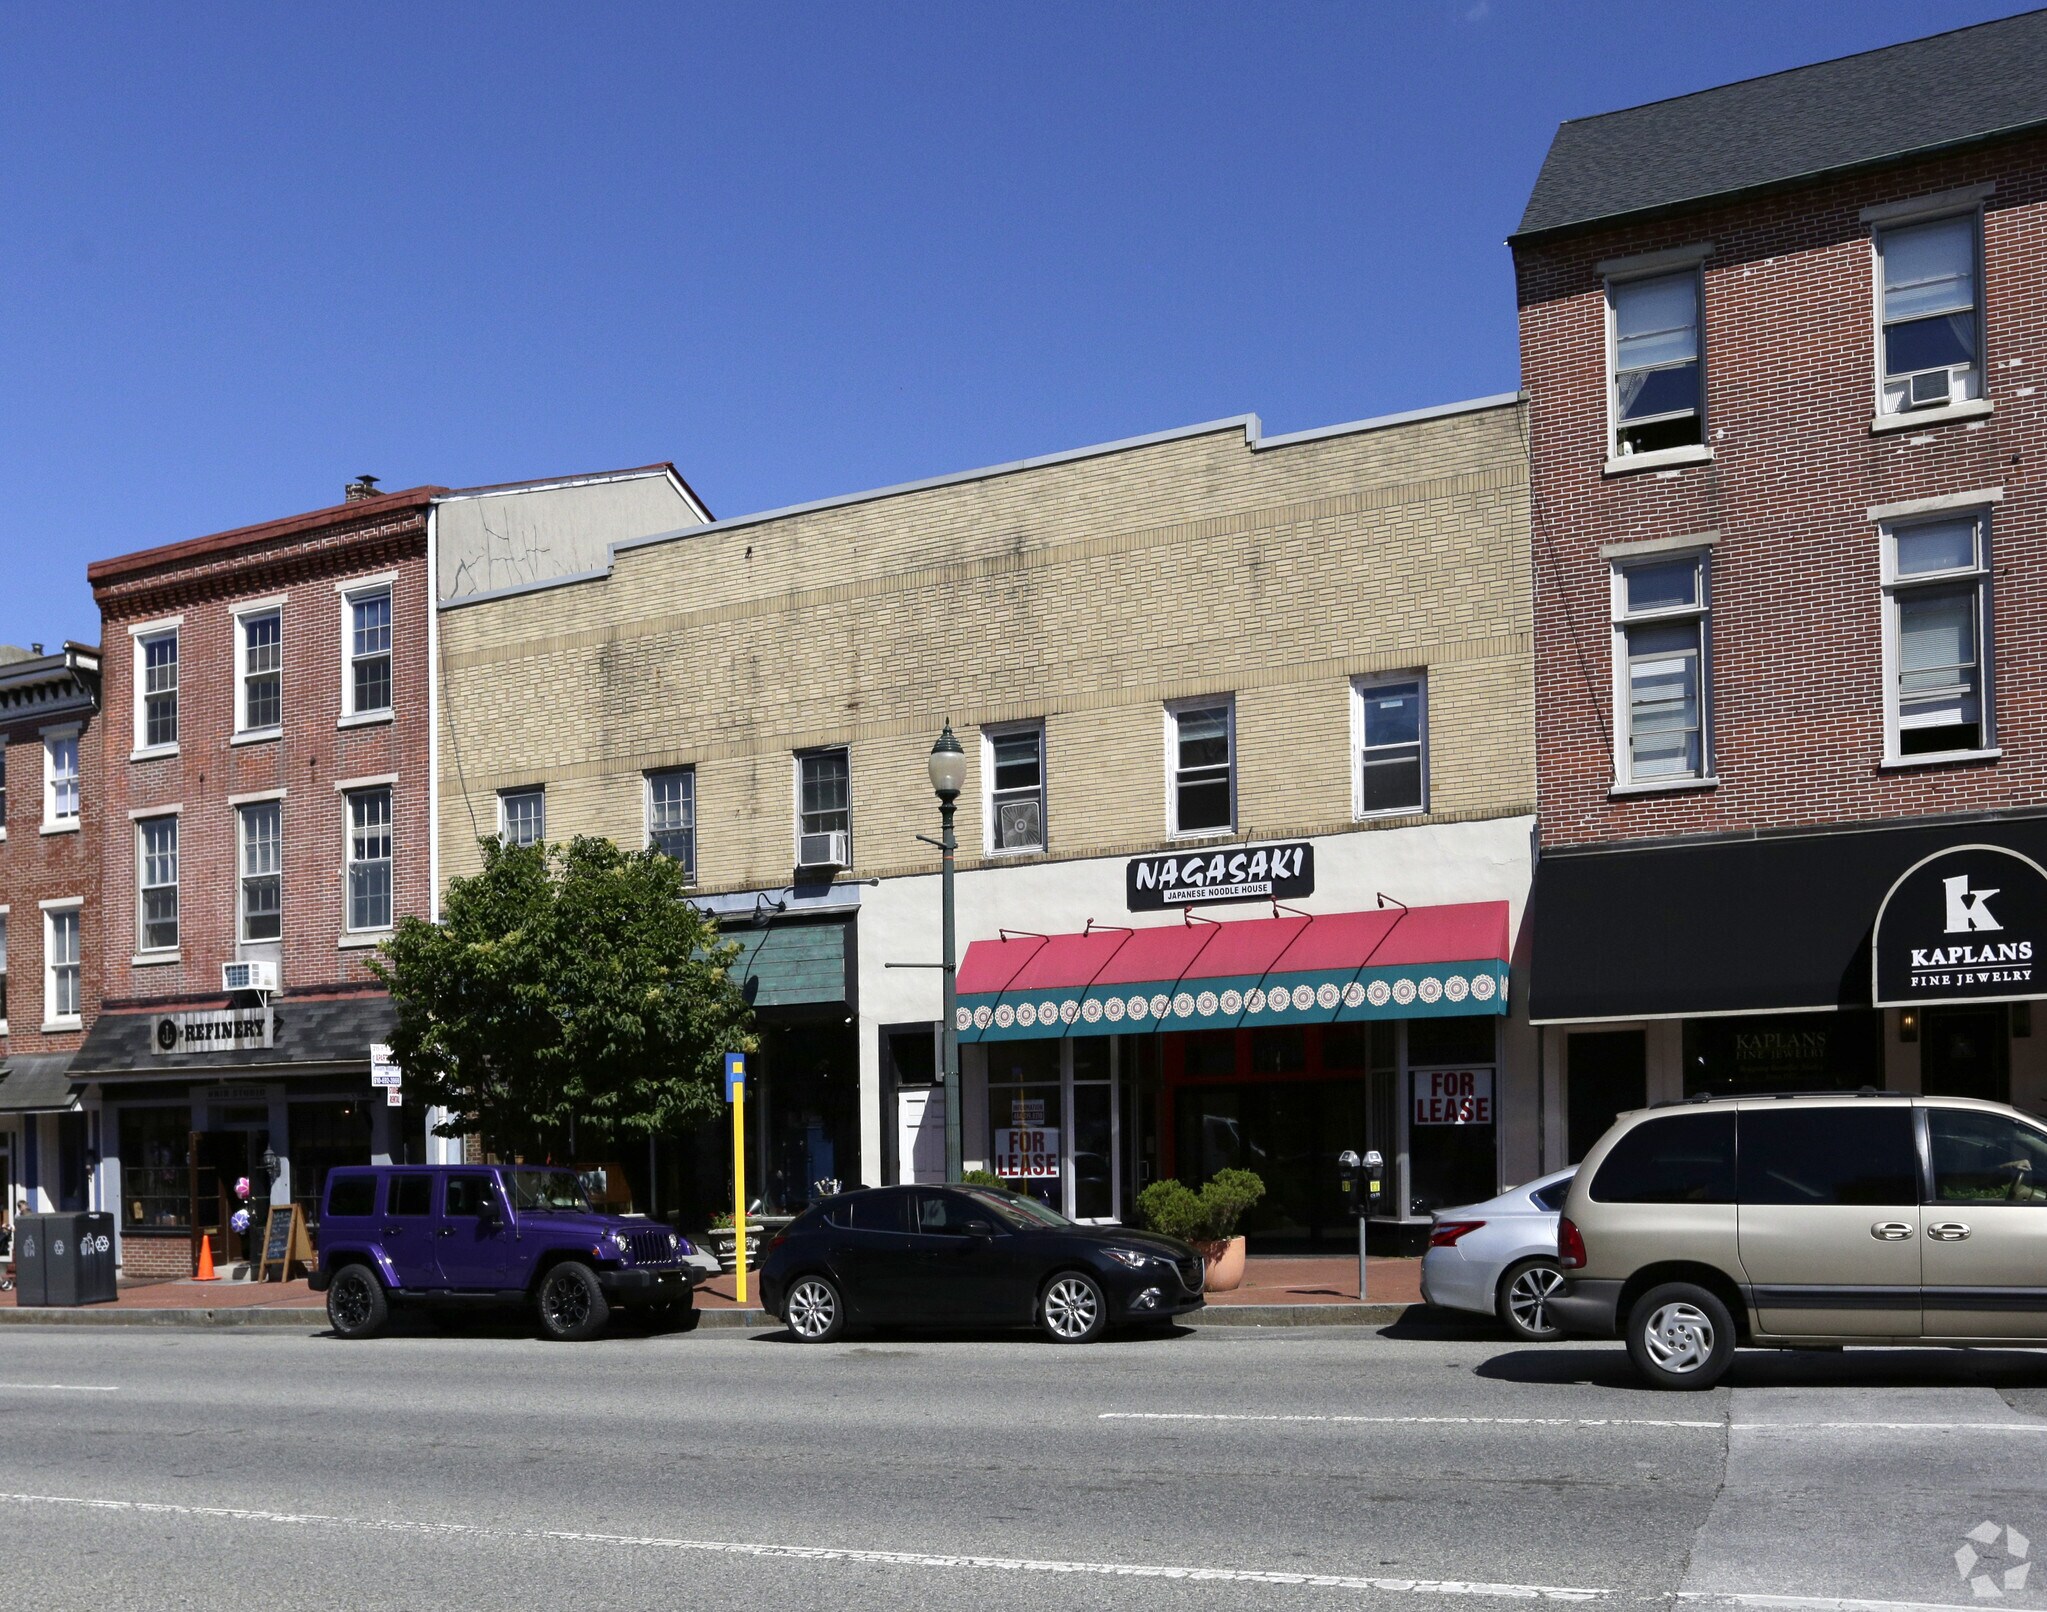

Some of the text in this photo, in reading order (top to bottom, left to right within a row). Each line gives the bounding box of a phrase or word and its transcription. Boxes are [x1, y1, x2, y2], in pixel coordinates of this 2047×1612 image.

[1136, 847, 1304, 891] NAGASAKI
[1167, 884, 1268, 900] JAPANESE NOODLE HOUSE
[1911, 941, 2033, 967] KAPLANS
[1911, 970, 2032, 987] FINE JEWELRY
[184, 1019, 266, 1042] REFINERY
[1735, 1031, 1827, 1049] KAPLANS
[1736, 1047, 1825, 1060] FINE JEWELRY
[1431, 1071, 1475, 1097] FOR
[1417, 1098, 1490, 1122] LEASE
[1009, 1131, 1045, 1153] FOR
[998, 1153, 1057, 1176] LEASE
